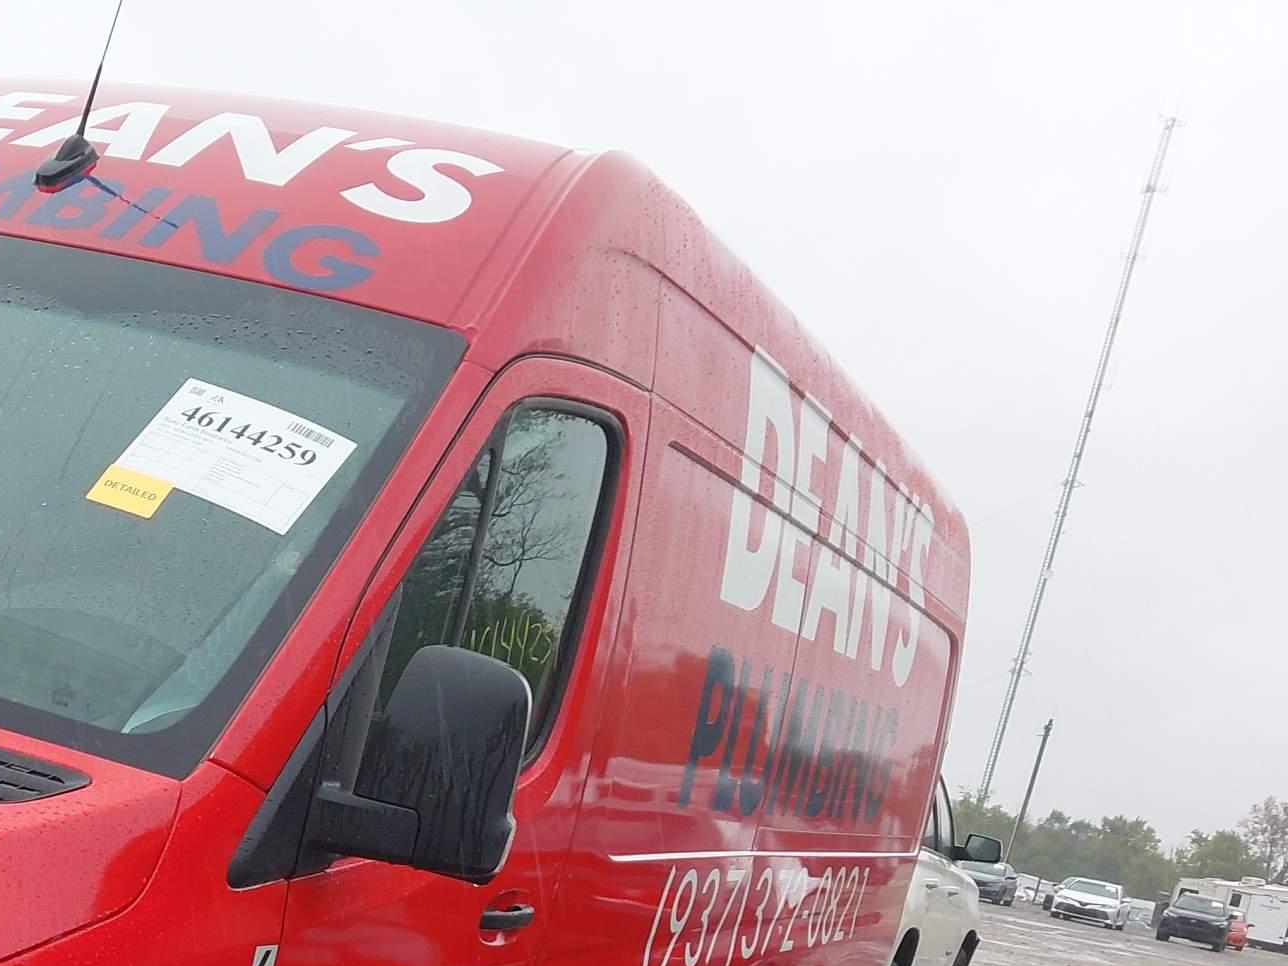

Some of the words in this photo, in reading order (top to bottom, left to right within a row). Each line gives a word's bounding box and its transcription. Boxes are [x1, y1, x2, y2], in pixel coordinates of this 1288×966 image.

[102, 478, 158, 502] DETAILED
[180, 405, 318, 466] 46144259
[719, 345, 935, 687] DEAN'S
[677, 644, 900, 825] PLUMBING
